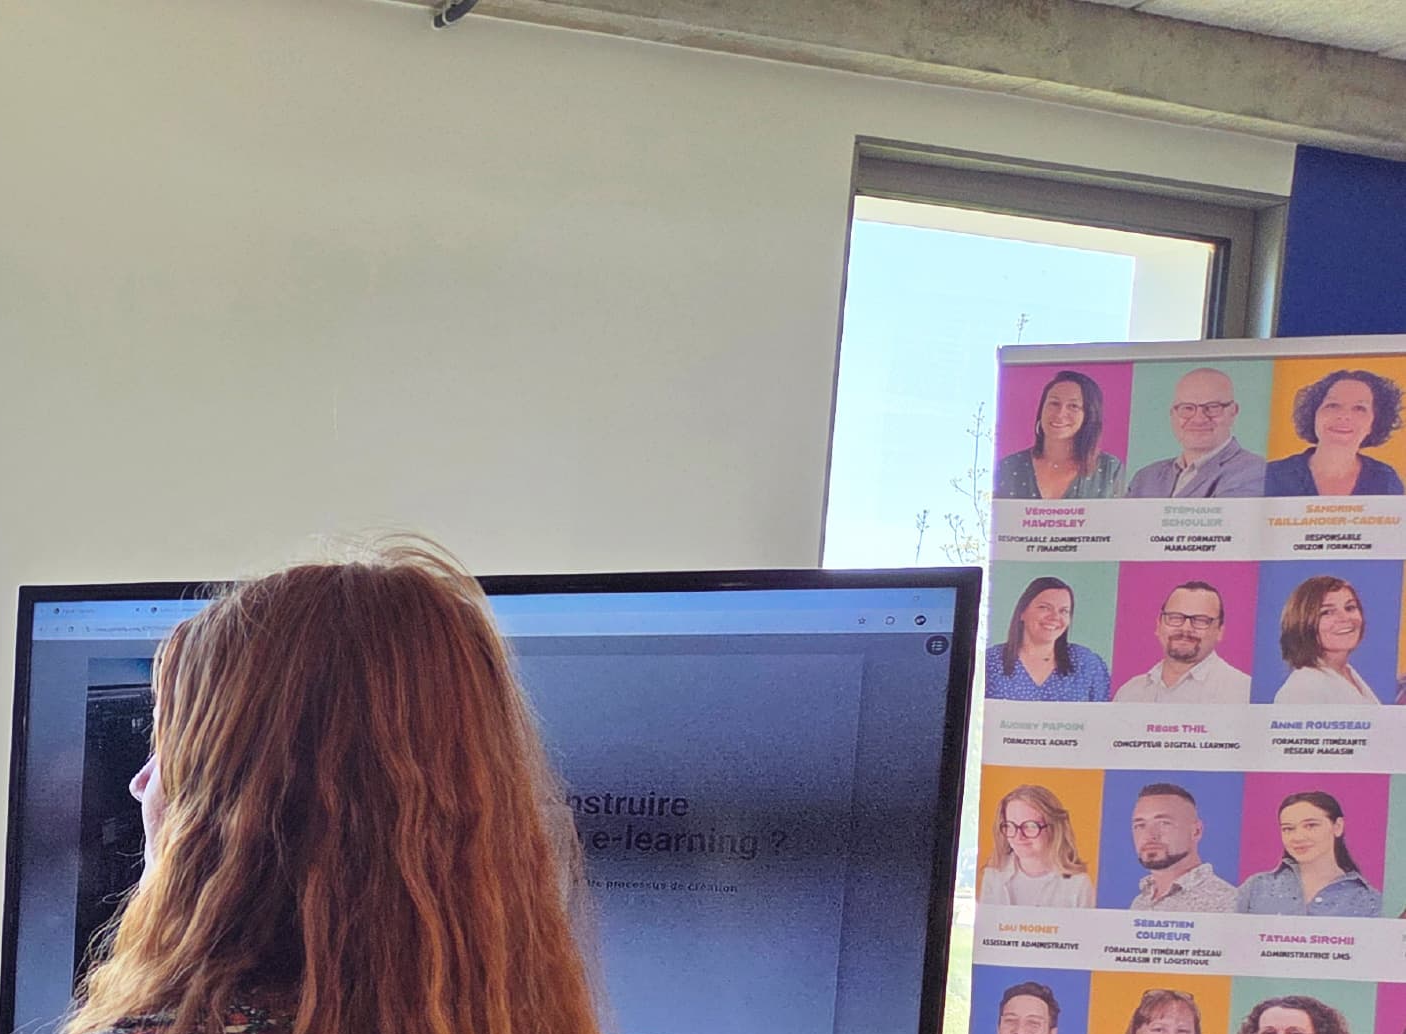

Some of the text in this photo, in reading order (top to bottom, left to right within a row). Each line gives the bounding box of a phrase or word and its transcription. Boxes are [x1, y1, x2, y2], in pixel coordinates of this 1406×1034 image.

[1305, 721, 1371, 729] ROUSSEAU
[567, 791, 689, 816] nstruire
[592, 825, 758, 860] e-learning
